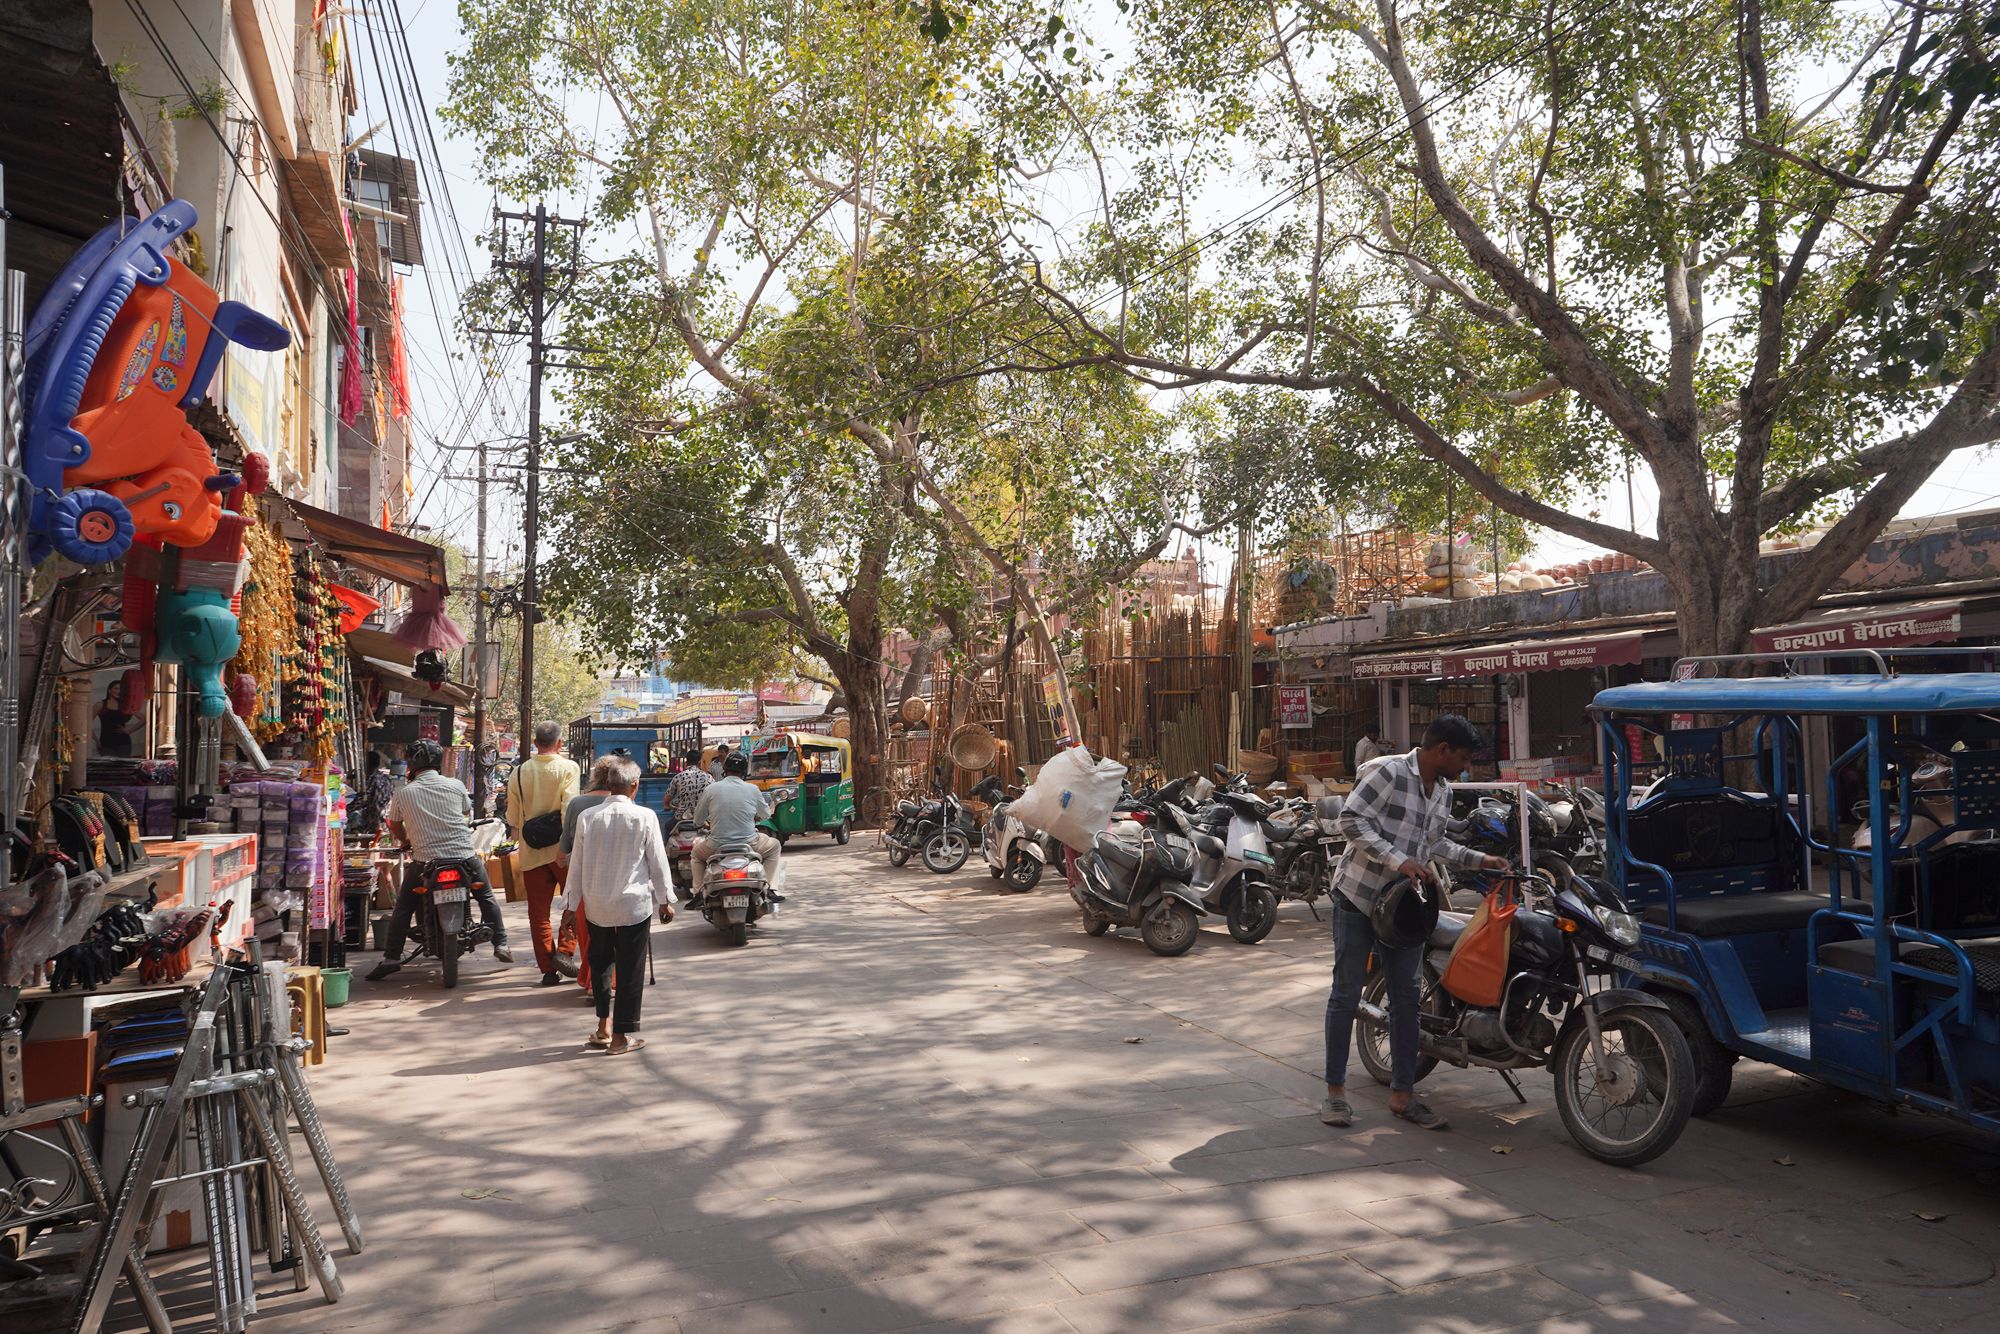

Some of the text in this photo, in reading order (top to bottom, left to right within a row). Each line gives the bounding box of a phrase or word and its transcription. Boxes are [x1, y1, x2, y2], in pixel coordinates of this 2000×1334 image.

[1773, 629, 1846, 651] कल्याण
[1355, 663, 1373, 677] मुकेश
[1373, 663, 1391, 675] कुमार
[1410, 661, 1430, 673] कुमार
[1464, 656, 1508, 671] कल्याण
[1281, 689, 1304, 698] लाख
